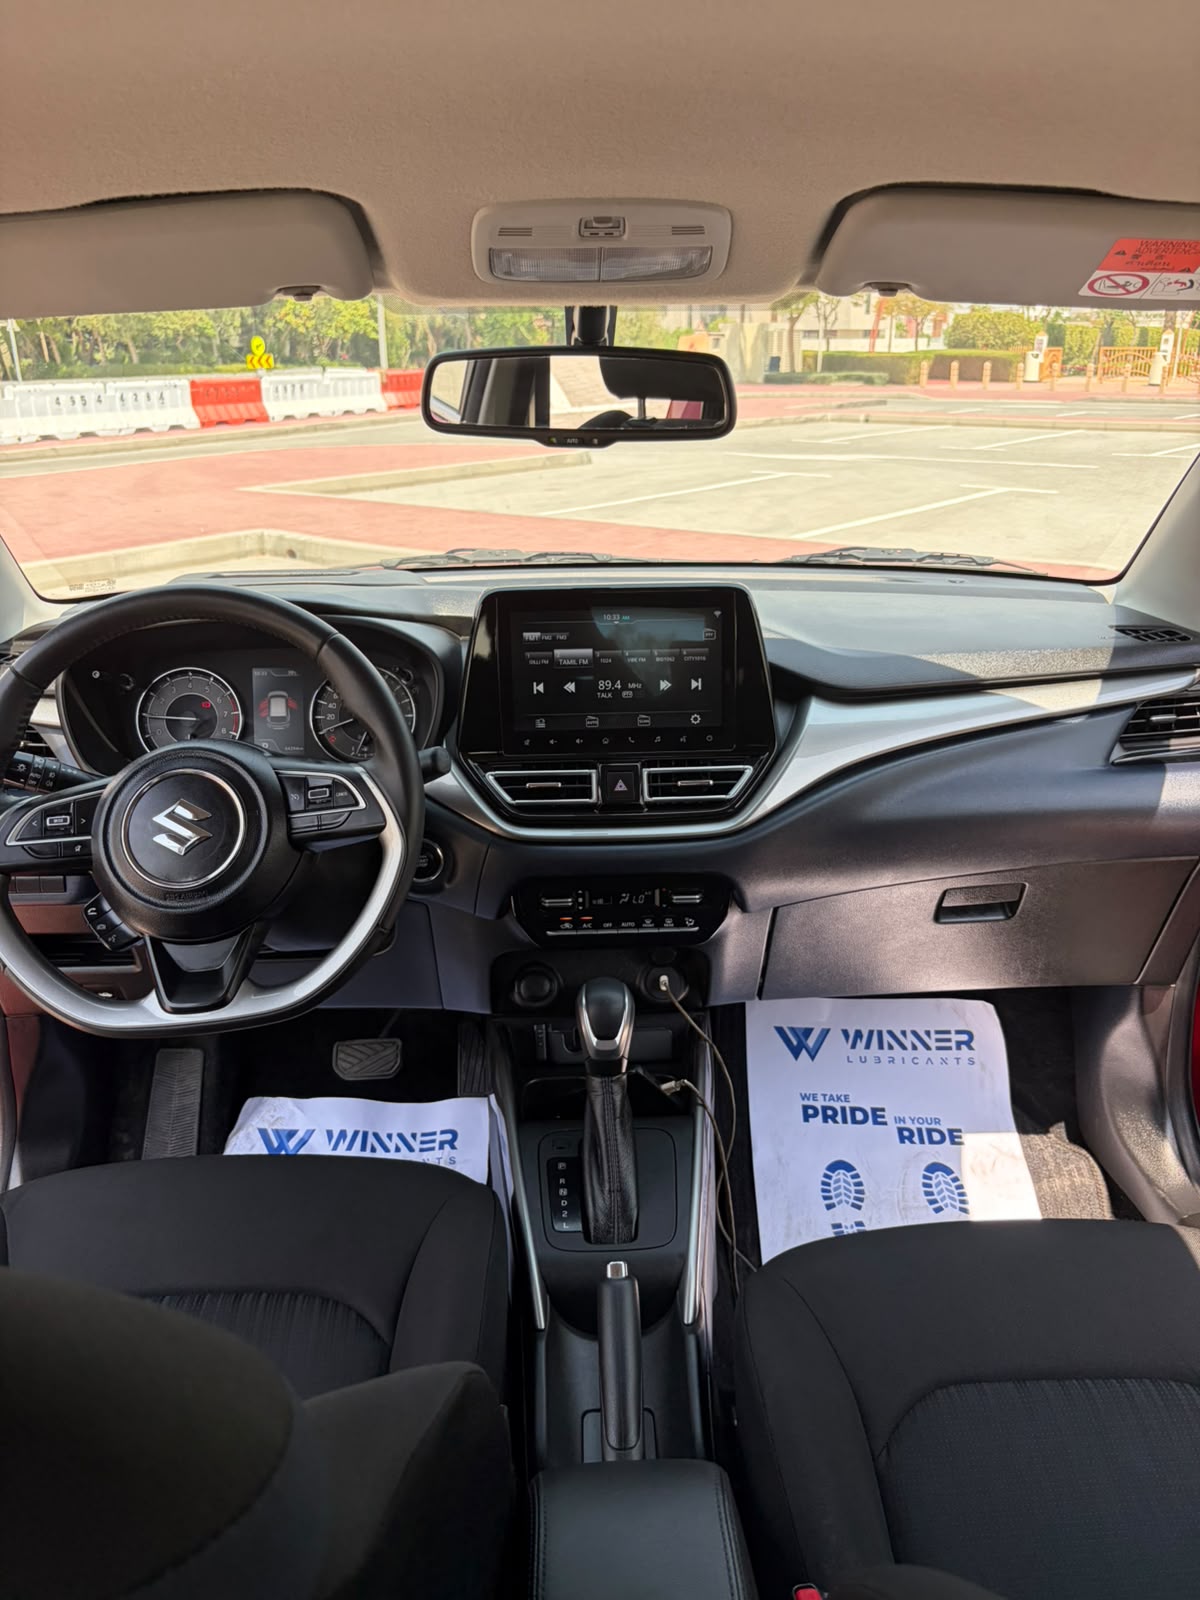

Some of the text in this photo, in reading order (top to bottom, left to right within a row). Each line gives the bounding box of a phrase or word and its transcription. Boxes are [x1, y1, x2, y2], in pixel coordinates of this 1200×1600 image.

[598, 680, 622, 690] 89.4
[841, 1029, 975, 1051] WINNER
[847, 1056, 976, 1065] LUBRICANTS
[800, 1093, 850, 1103] WE TAKE
[802, 1105, 887, 1126] PRIDE
[894, 1116, 941, 1126] IN YOUR
[326, 1129, 458, 1153] WINNER
[896, 1127, 965, 1146] RIDE
